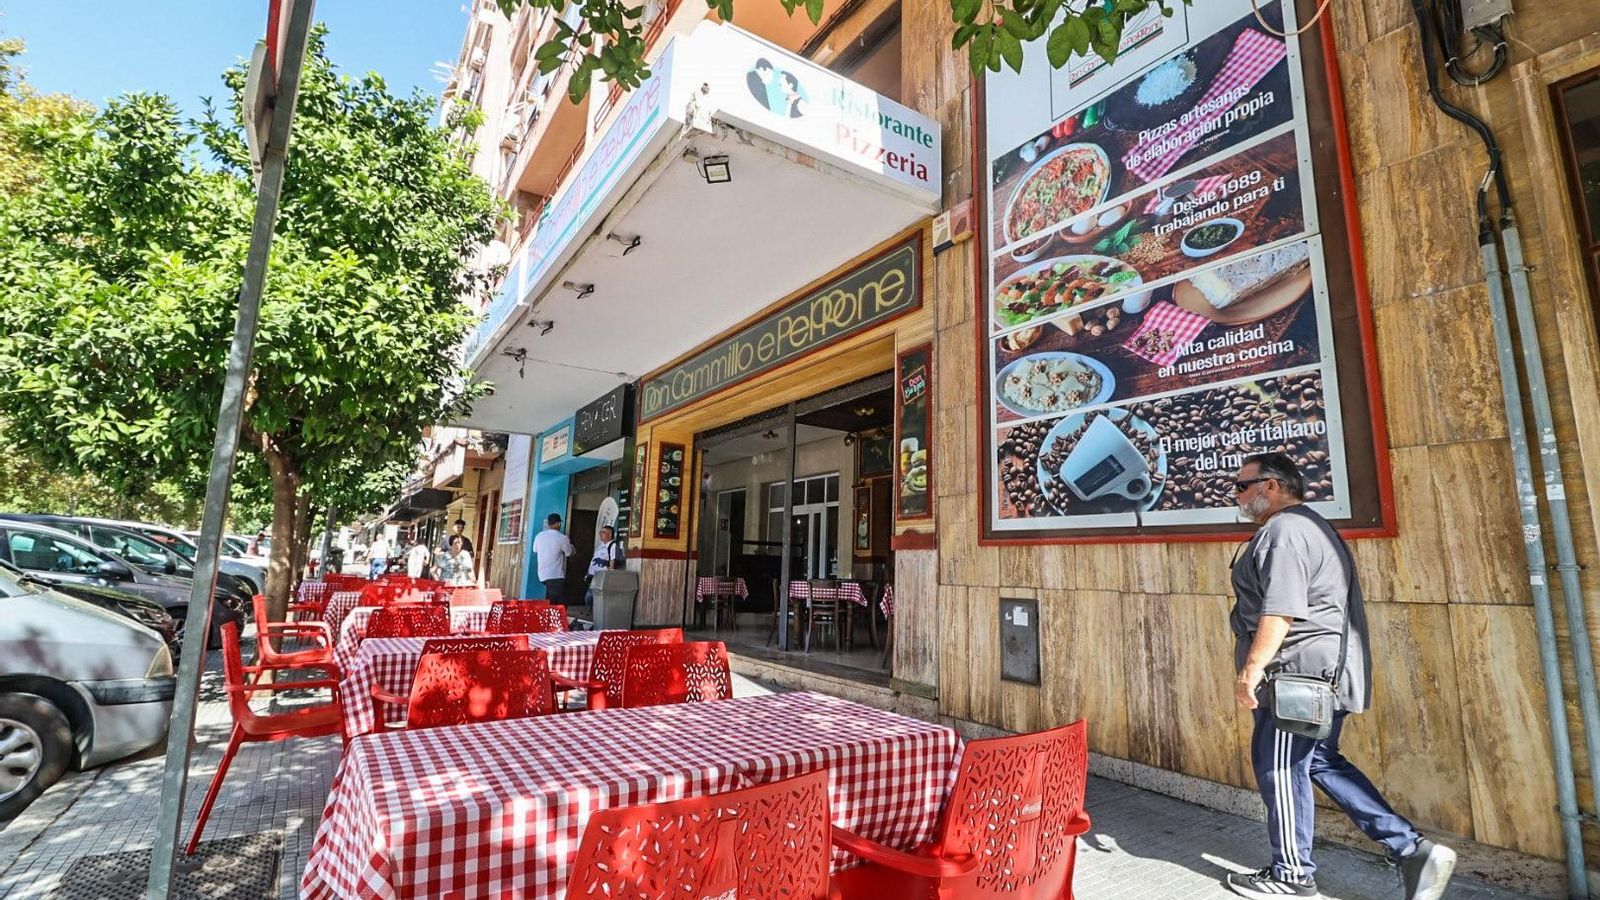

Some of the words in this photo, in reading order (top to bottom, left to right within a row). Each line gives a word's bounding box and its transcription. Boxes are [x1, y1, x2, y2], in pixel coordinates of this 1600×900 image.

[832, 87, 934, 148] Ristorante
[1125, 154, 1141, 170] de
[1144, 115, 1222, 161] elaboración
[1225, 91, 1274, 127] propia
[1138, 118, 1178, 146] Pizzas
[1180, 82, 1251, 125] artesanas
[835, 123, 929, 182] Pizzeria
[1152, 197, 1229, 237] Trabajando
[1233, 186, 1269, 210] para
[1273, 176, 1285, 192] ti
[1173, 190, 1217, 215] Desde
[1221, 170, 1261, 199] 1989
[644, 384, 670, 414] Don
[672, 341, 754, 400] Cammillo
[757, 332, 775, 362] e
[777, 269, 905, 355] Peppone
[1158, 363, 1175, 378] en
[1178, 351, 1235, 374] nuestra
[1239, 339, 1295, 361] cocina
[1174, 341, 1204, 357] Alta
[1207, 323, 1264, 351] calidad
[1159, 437, 1172, 454] El
[1174, 433, 1217, 452] mejor
[1221, 424, 1256, 446] café
[1260, 420, 1326, 442] italiano
[1195, 451, 1218, 471] del
